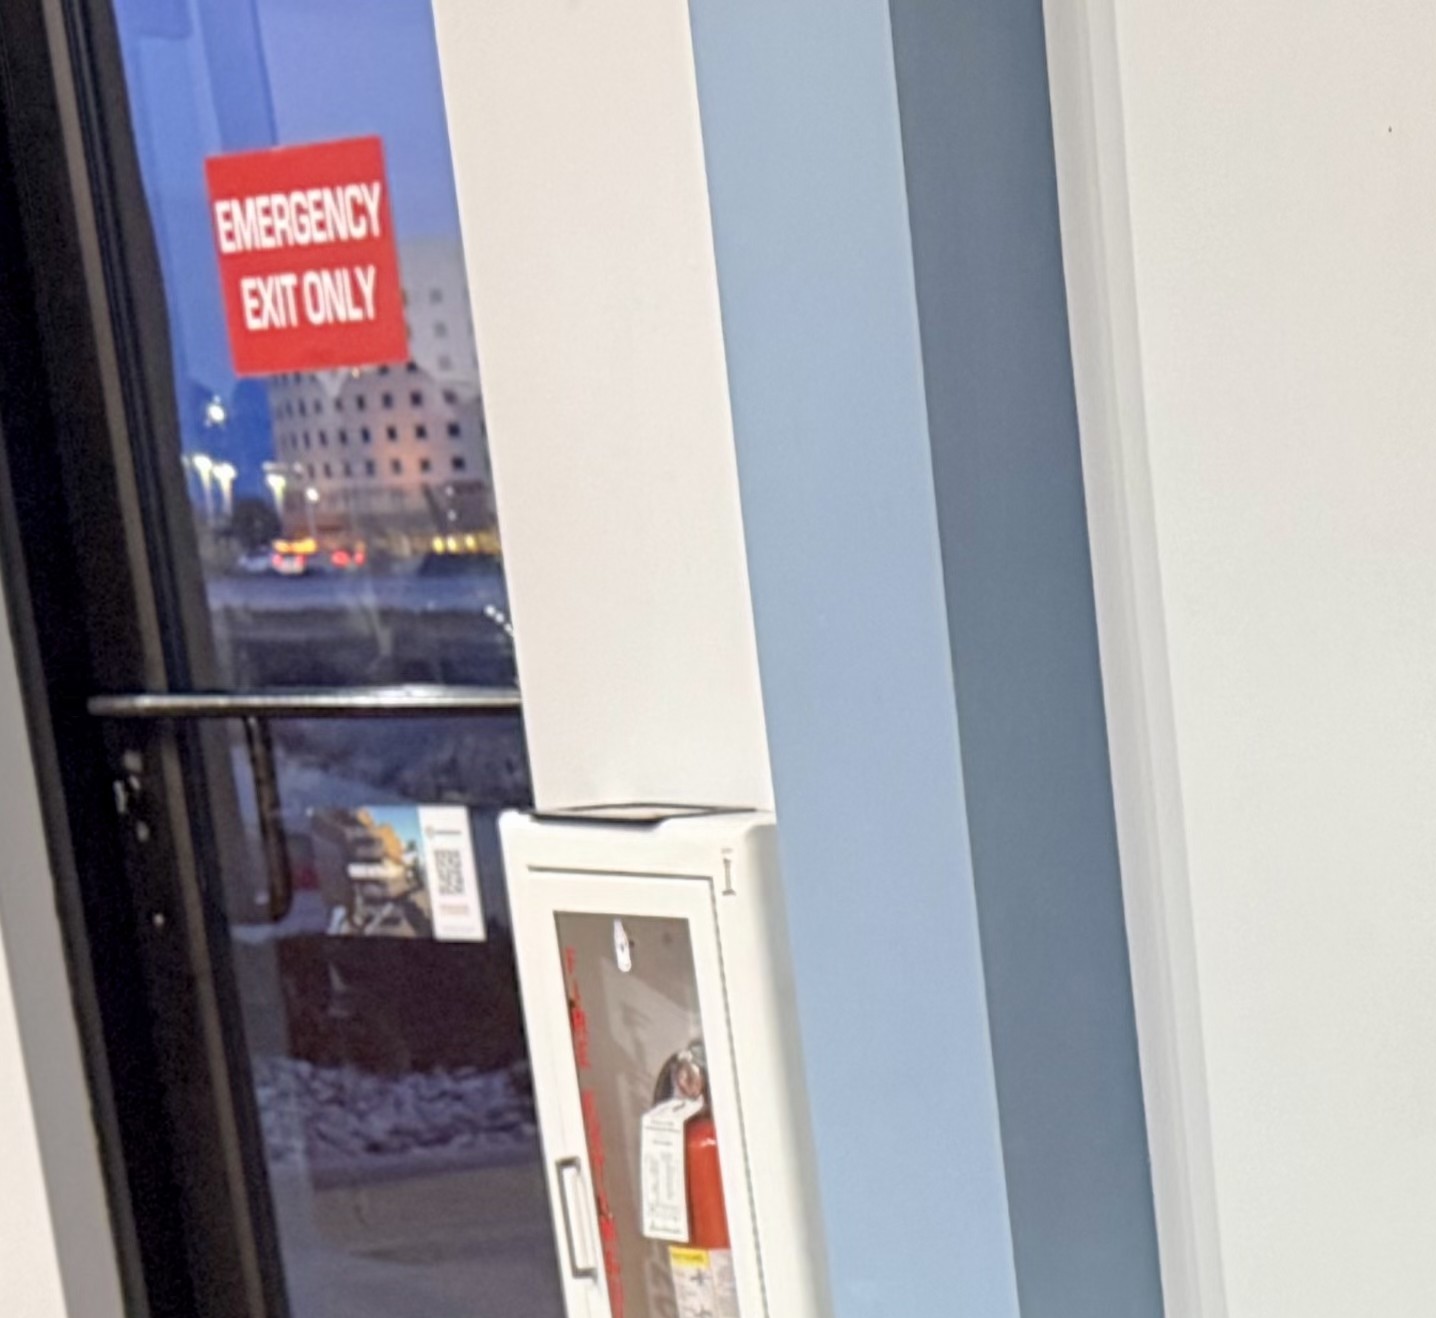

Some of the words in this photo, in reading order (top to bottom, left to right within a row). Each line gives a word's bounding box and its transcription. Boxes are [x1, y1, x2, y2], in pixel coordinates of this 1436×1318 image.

[214, 182, 382, 254] EMERGENCY
[240, 273, 298, 331] EXIT
[302, 264, 376, 326] ONLY
